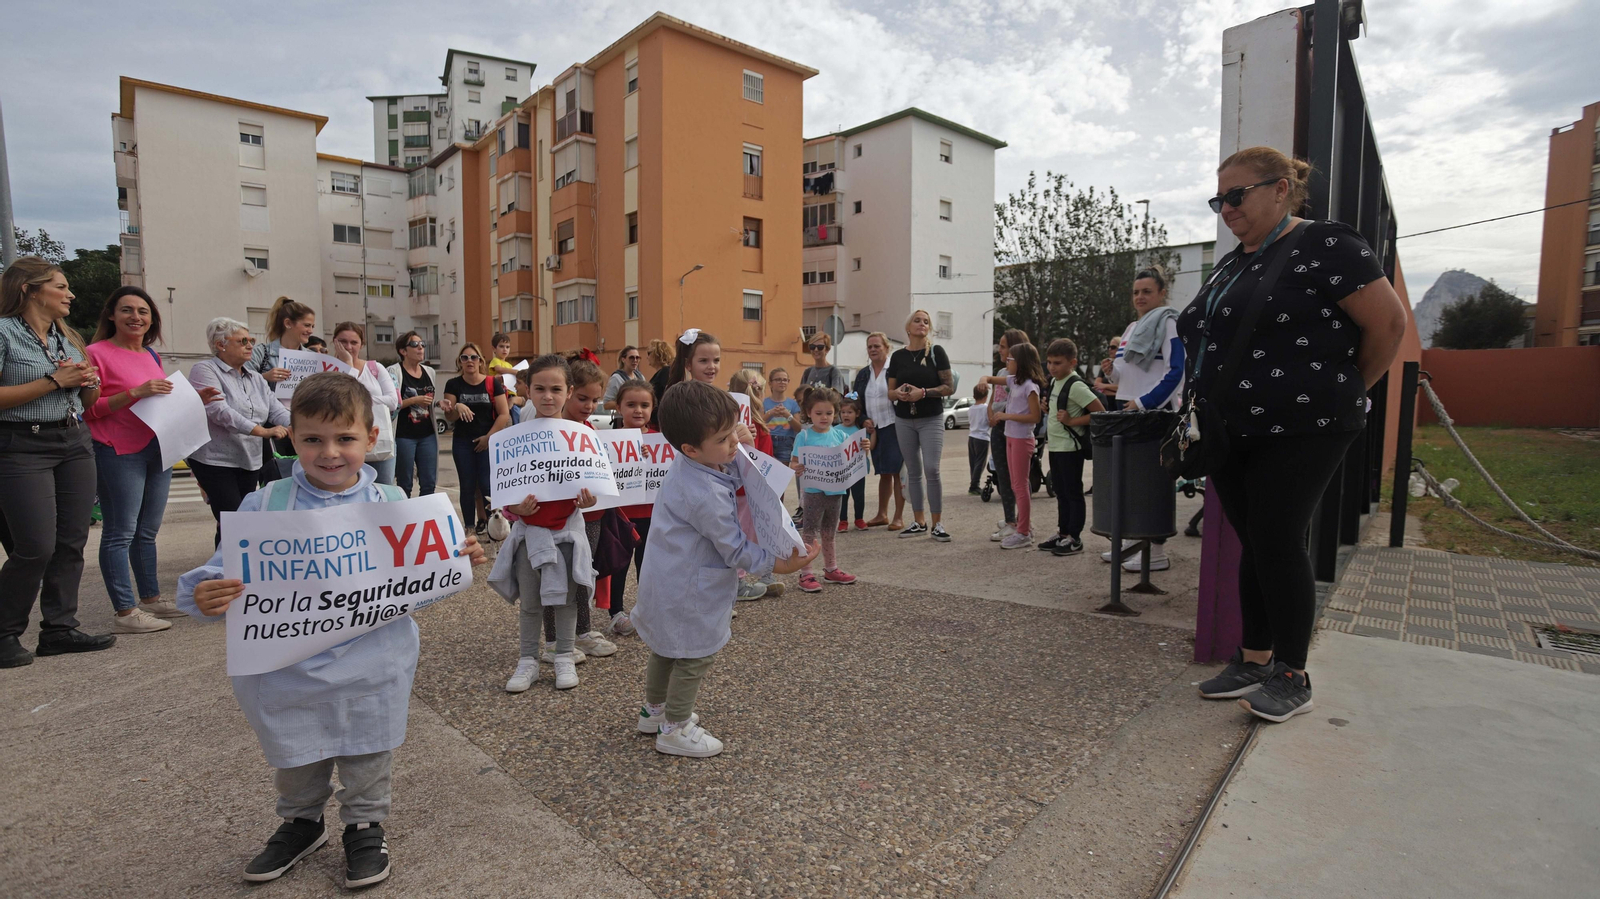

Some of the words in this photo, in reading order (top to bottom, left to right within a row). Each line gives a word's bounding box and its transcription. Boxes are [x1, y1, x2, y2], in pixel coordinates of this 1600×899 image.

[288, 365, 317, 373] INFANTIL
[289, 358, 318, 366] COMEDOR
[502, 430, 554, 449] COMEDOR
[559, 429, 603, 457] YA!
[503, 440, 561, 461] INFANTIL
[611, 440, 643, 464] YA!
[496, 466, 515, 479] Por
[516, 462, 527, 474] la
[530, 456, 592, 472] Seguridad
[594, 459, 607, 470] de
[808, 452, 842, 461] COMEDOR
[808, 459, 844, 468] INFANTIL
[825, 457, 857, 478] Seguridad
[857, 454, 864, 463] de
[496, 473, 545, 491] nuestros
[547, 469, 581, 484] hij@s
[613, 466, 634, 479] ridad
[634, 466, 643, 477] de
[804, 474, 834, 484] nuestros
[645, 479, 661, 491] j@s
[258, 529, 366, 556] COMEDOR
[379, 514, 460, 567] YA!
[260, 550, 377, 581] INFANTIL
[243, 593, 285, 615] Por
[290, 590, 312, 613] la
[317, 571, 436, 612] Seguridad
[439, 568, 462, 589] de
[243, 615, 345, 641] nuestros
[349, 603, 409, 628] hij@s
